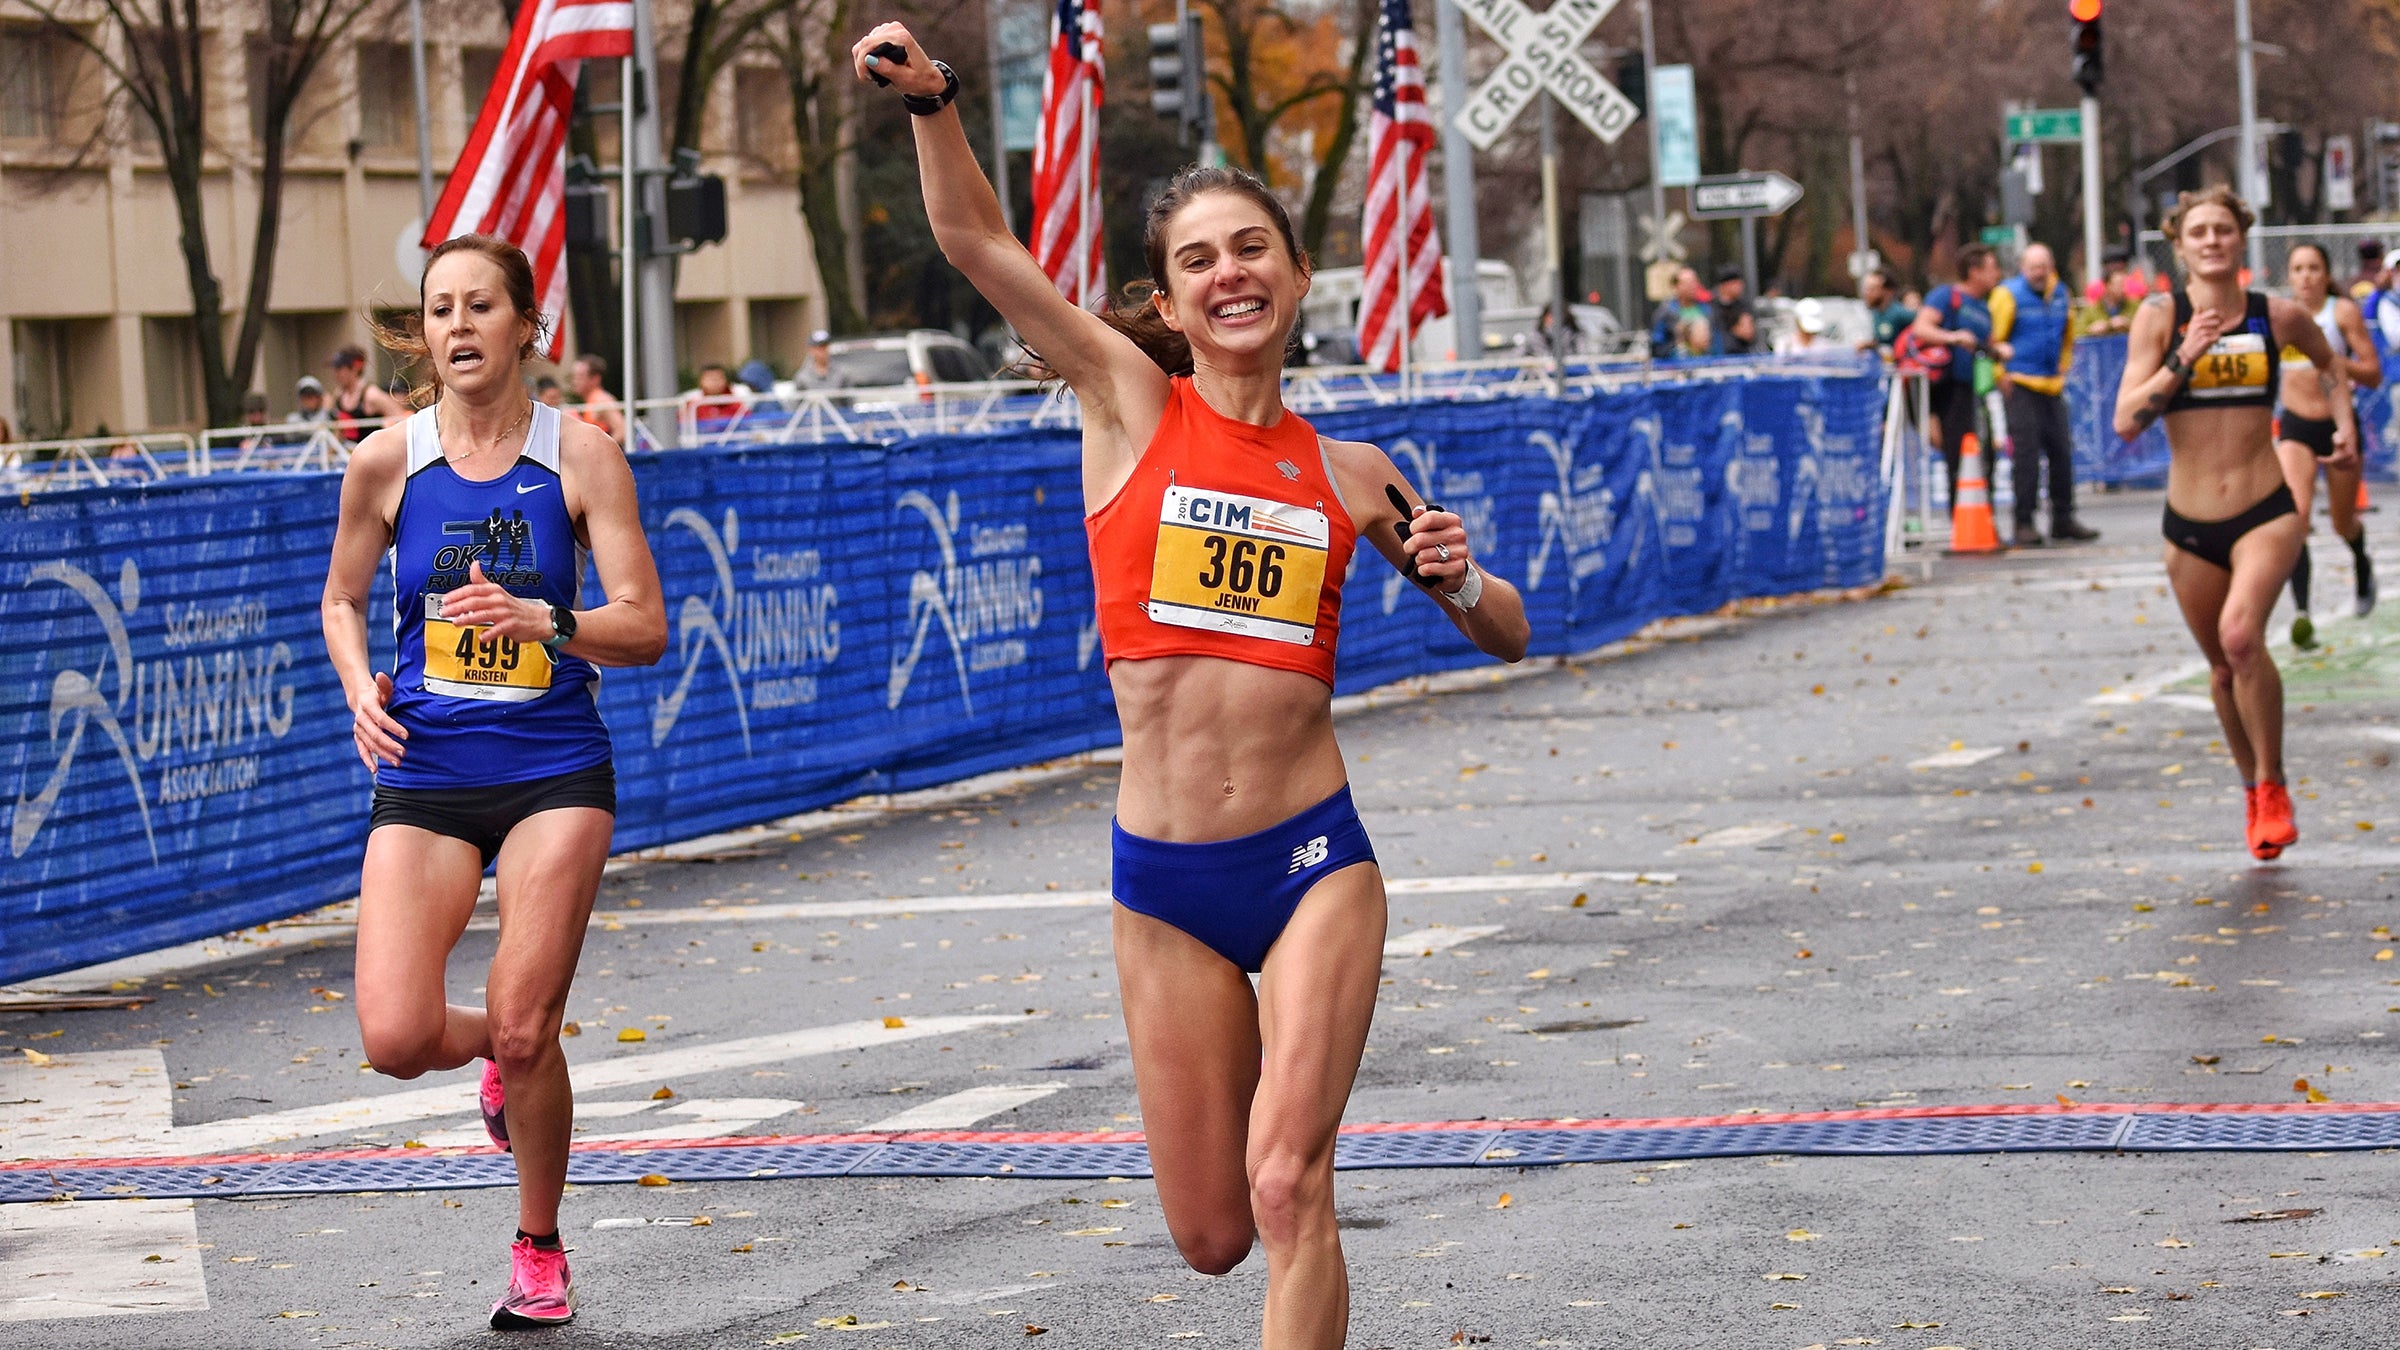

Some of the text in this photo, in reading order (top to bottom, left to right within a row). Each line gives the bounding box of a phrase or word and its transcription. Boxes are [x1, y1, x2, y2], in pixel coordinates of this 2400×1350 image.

[1550, 57, 1627, 131] ROAD
[2210, 353, 2249, 379] 446
[1177, 495, 1188, 520] 2019
[1189, 498, 1252, 531] CIM
[433, 544, 487, 572] OK
[1199, 535, 1286, 598] 366
[425, 570, 544, 591] RUNER
[1214, 592, 1260, 613] JENNY
[455, 628, 520, 671] 499
[464, 668, 508, 683] KRISTEN
[158, 754, 261, 805] ASSOCIATION
[1287, 835, 1329, 875] NB
